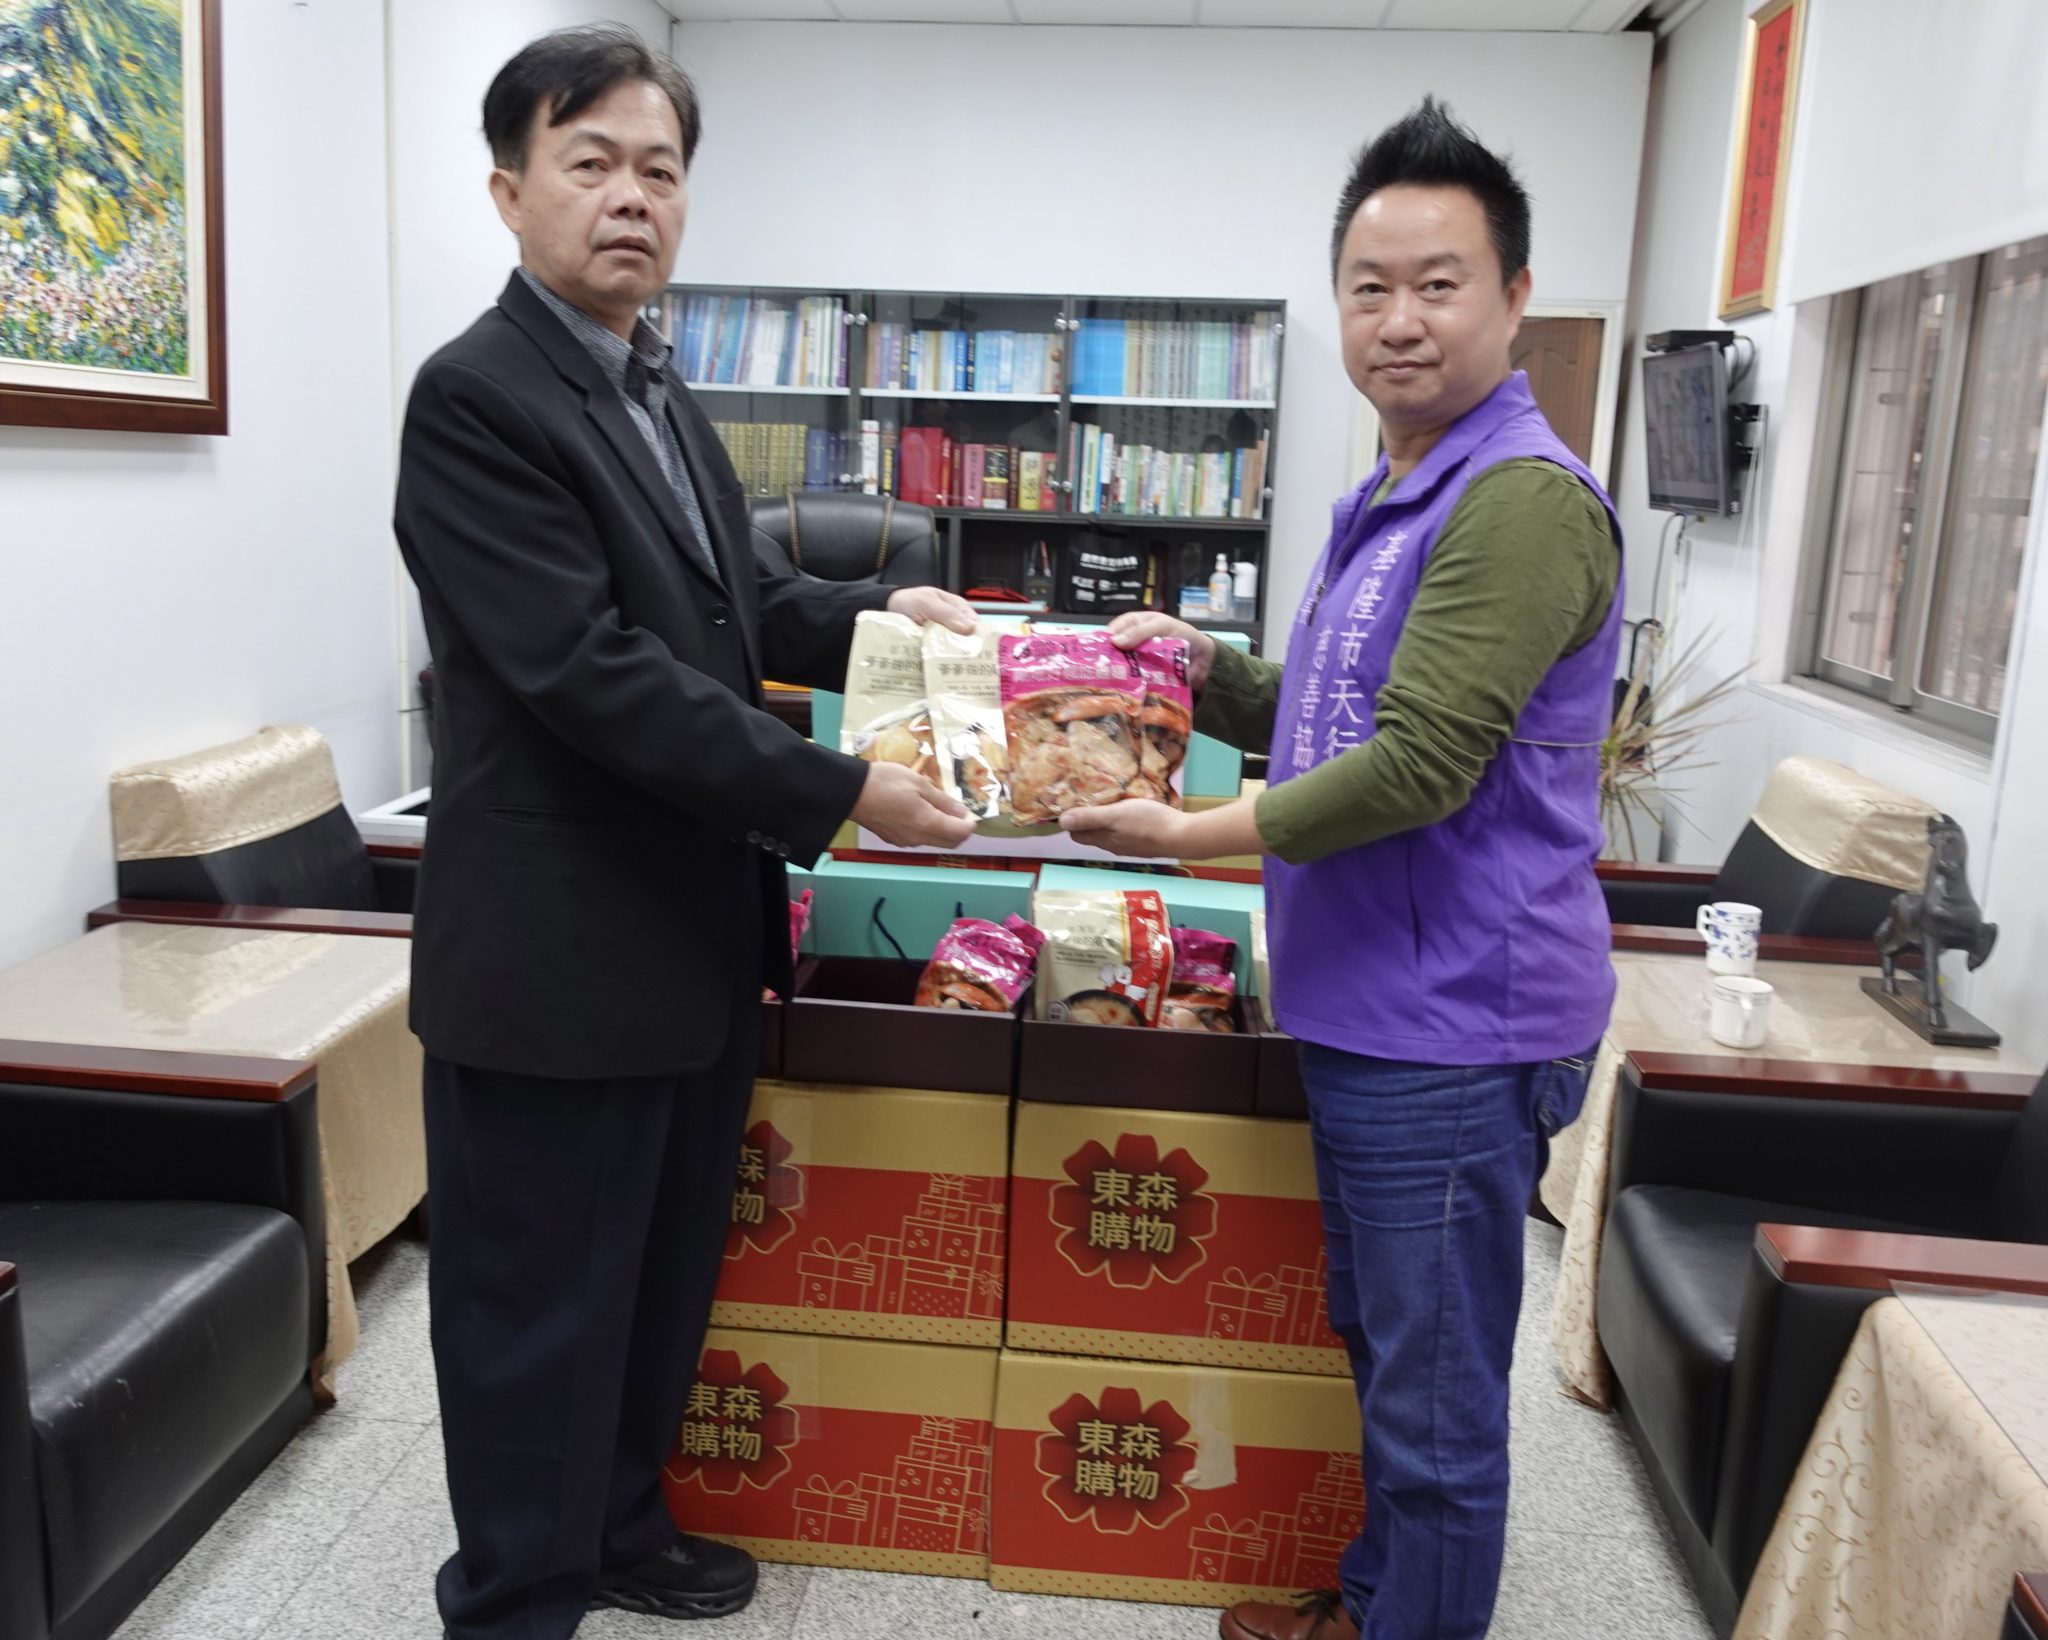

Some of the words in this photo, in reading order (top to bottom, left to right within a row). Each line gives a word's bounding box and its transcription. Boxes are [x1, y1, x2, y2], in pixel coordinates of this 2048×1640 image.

[1090, 1168, 1179, 1212] 東森
[1087, 1210, 1177, 1254] 購物
[683, 1381, 763, 1421] 東森
[681, 1421, 762, 1462] 購物
[1076, 1419, 1162, 1460] 東森
[1073, 1459, 1160, 1500] 購物
